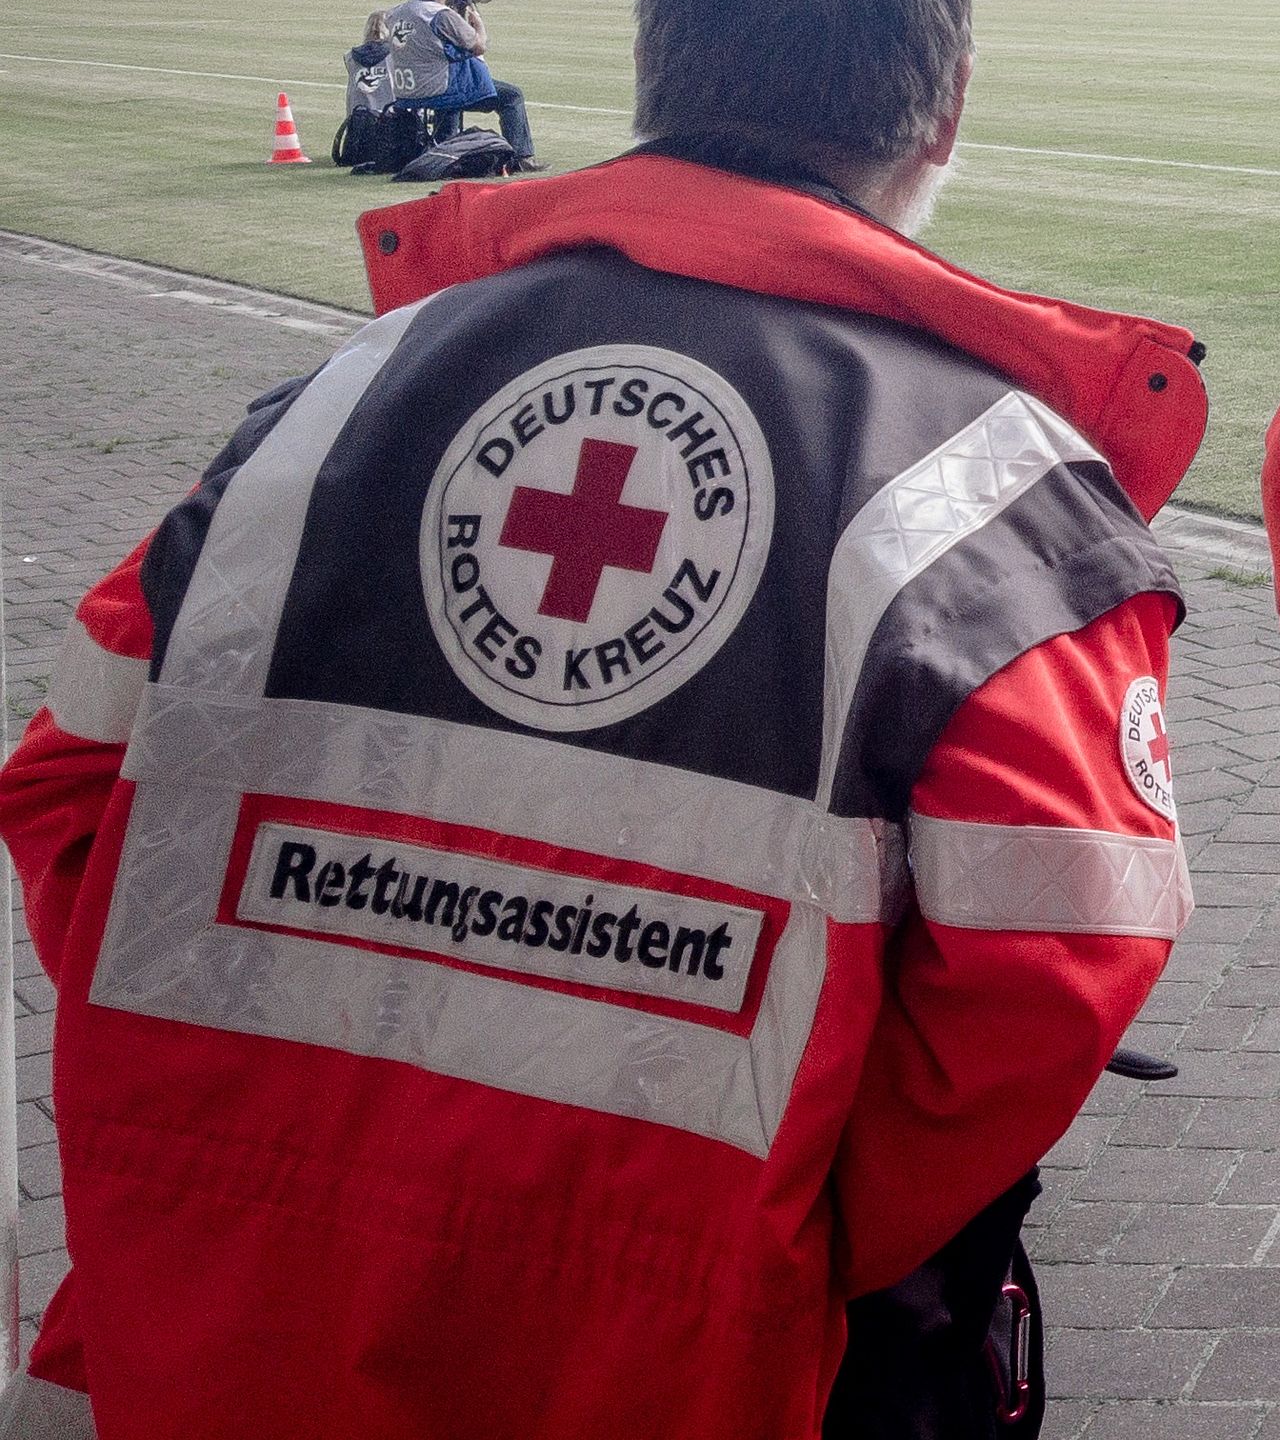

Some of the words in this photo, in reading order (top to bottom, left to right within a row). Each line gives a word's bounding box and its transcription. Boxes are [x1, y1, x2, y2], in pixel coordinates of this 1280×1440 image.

[394, 68, 415, 90] 03
[476, 377, 735, 521] DEUTSCHES
[447, 514, 543, 679] ROTES
[563, 558, 721, 691] KREUZ
[1128, 687, 1157, 742] DEUTSC
